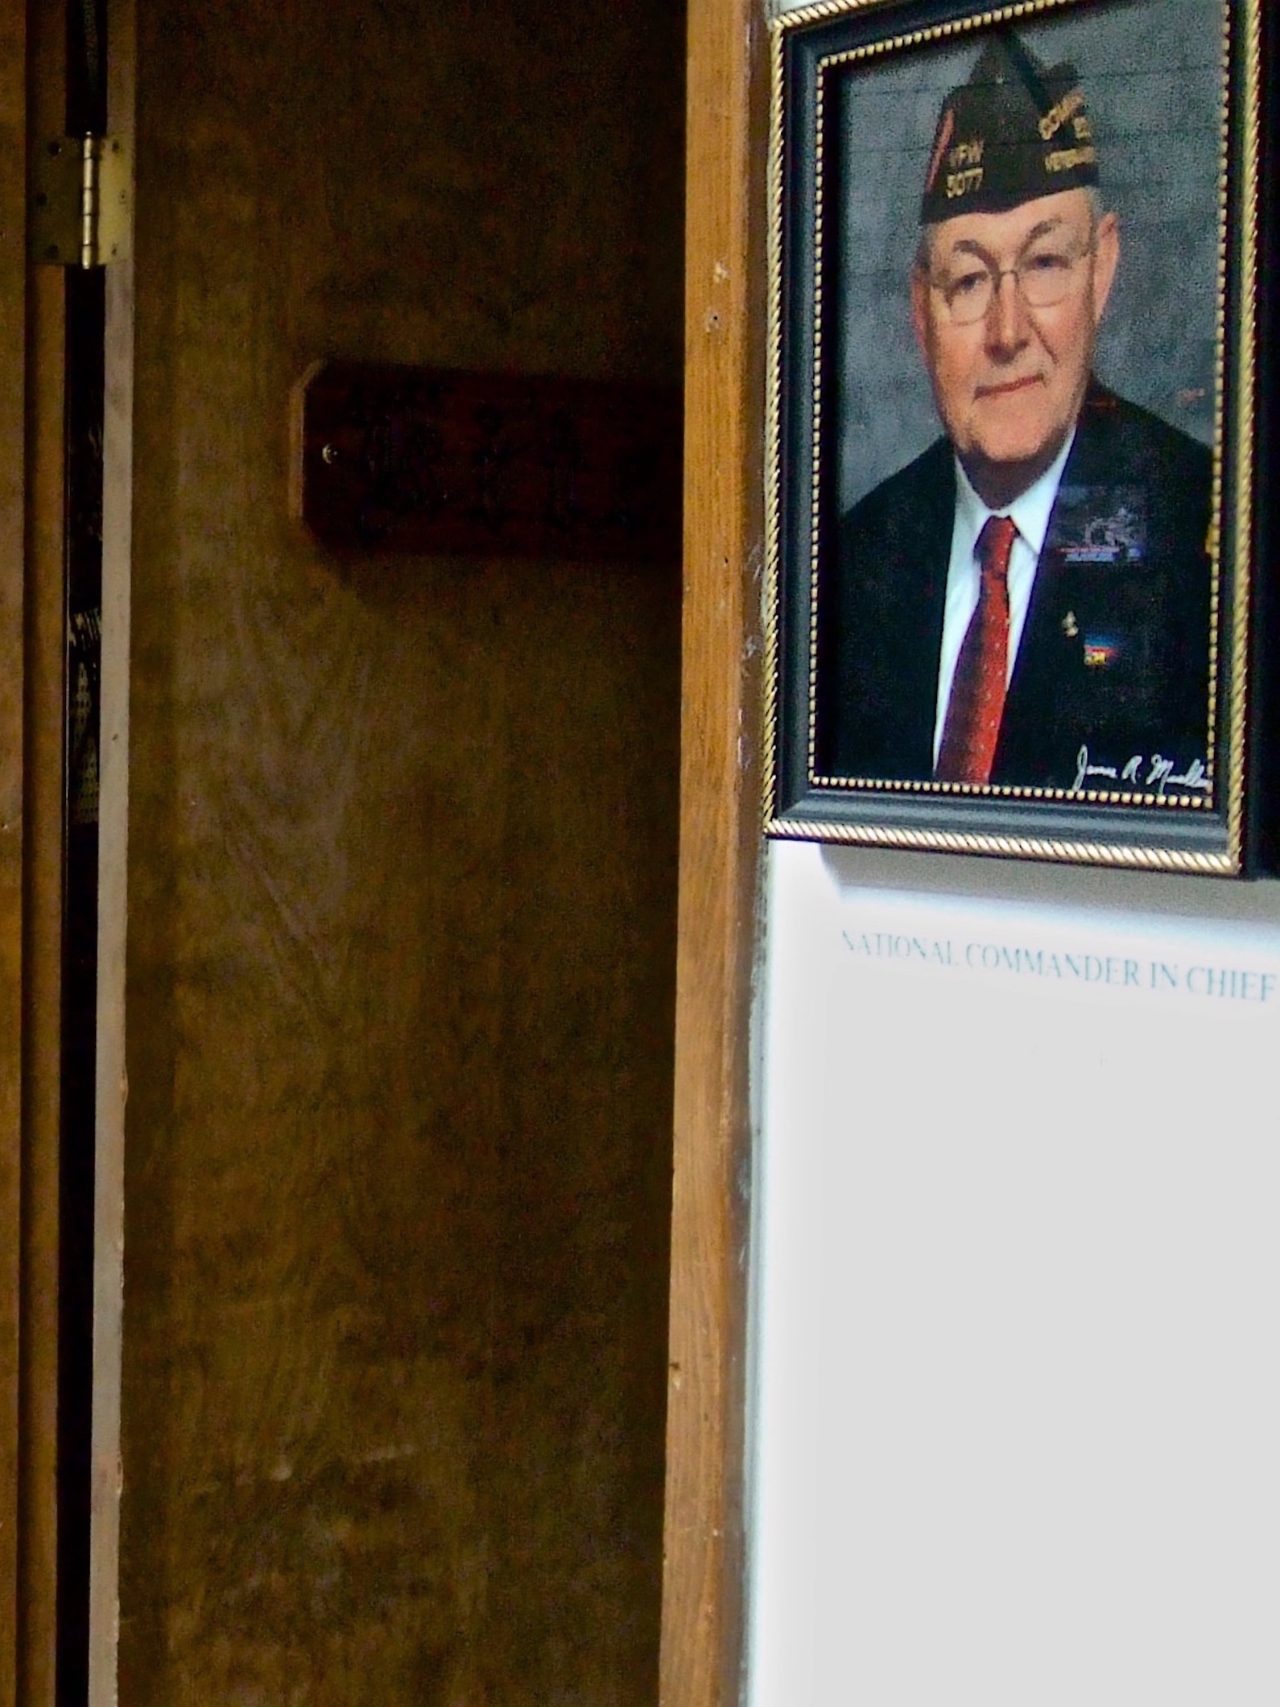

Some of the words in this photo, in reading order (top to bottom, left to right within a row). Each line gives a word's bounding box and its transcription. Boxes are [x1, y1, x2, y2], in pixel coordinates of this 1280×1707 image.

[841, 930, 960, 967] NATIONAL
[966, 943, 1140, 987] COMMANDER
[1149, 961, 1179, 988] IN
[1186, 966, 1277, 1002] CHIEF
